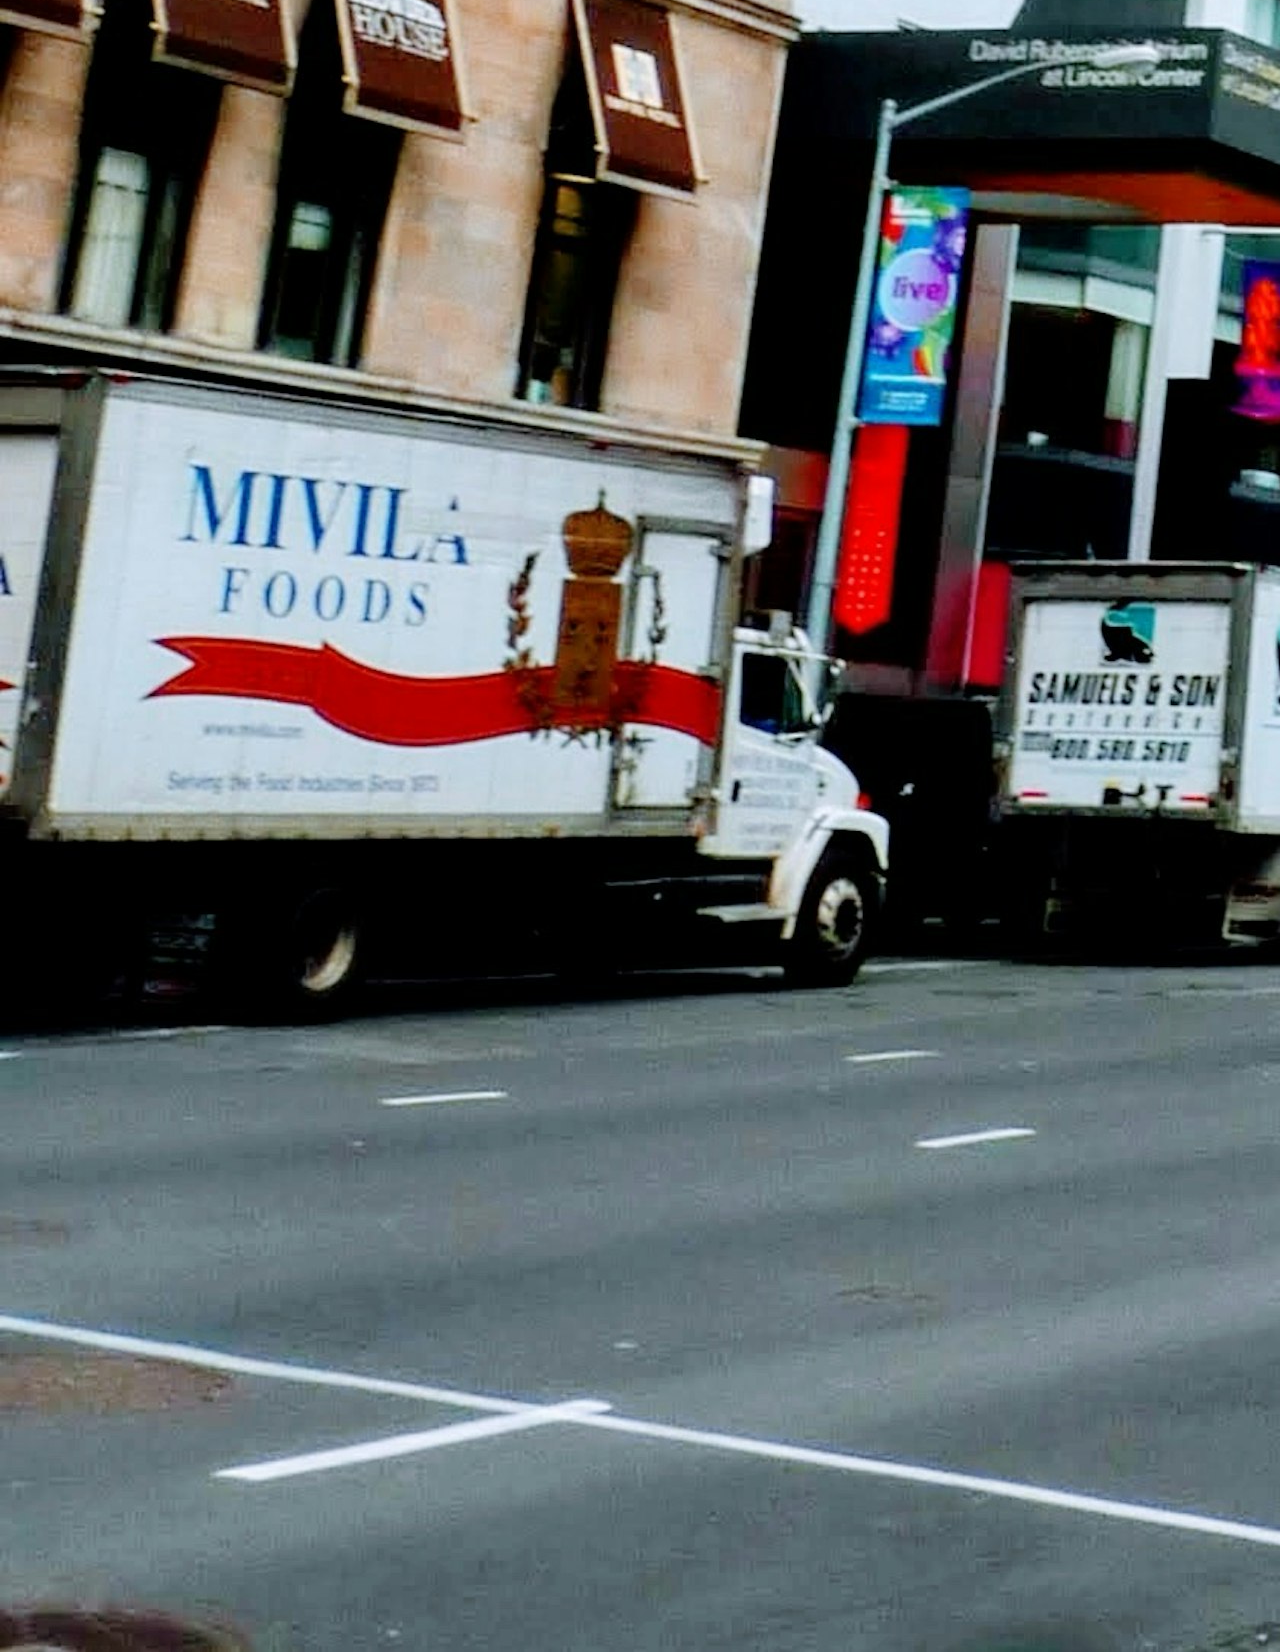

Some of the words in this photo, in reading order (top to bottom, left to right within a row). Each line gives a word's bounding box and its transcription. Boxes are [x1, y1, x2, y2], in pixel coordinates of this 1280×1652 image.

[353, 4, 448, 57] HOUSE
[969, 39, 1028, 61] David
[1041, 67, 1063, 86] at
[1138, 67, 1204, 86] Center
[893, 275, 945, 301] live
[178, 463, 471, 565] MIVILA
[218, 566, 431, 627] FOODS
[1028, 672, 1138, 705] SAMUELS
[1145, 674, 1162, 706] &
[1170, 674, 1220, 707] SON
[168, 771, 223, 795] Serving
[230, 773, 250, 791] the
[256, 773, 295, 792] Food
[368, 774, 405, 793] Since
